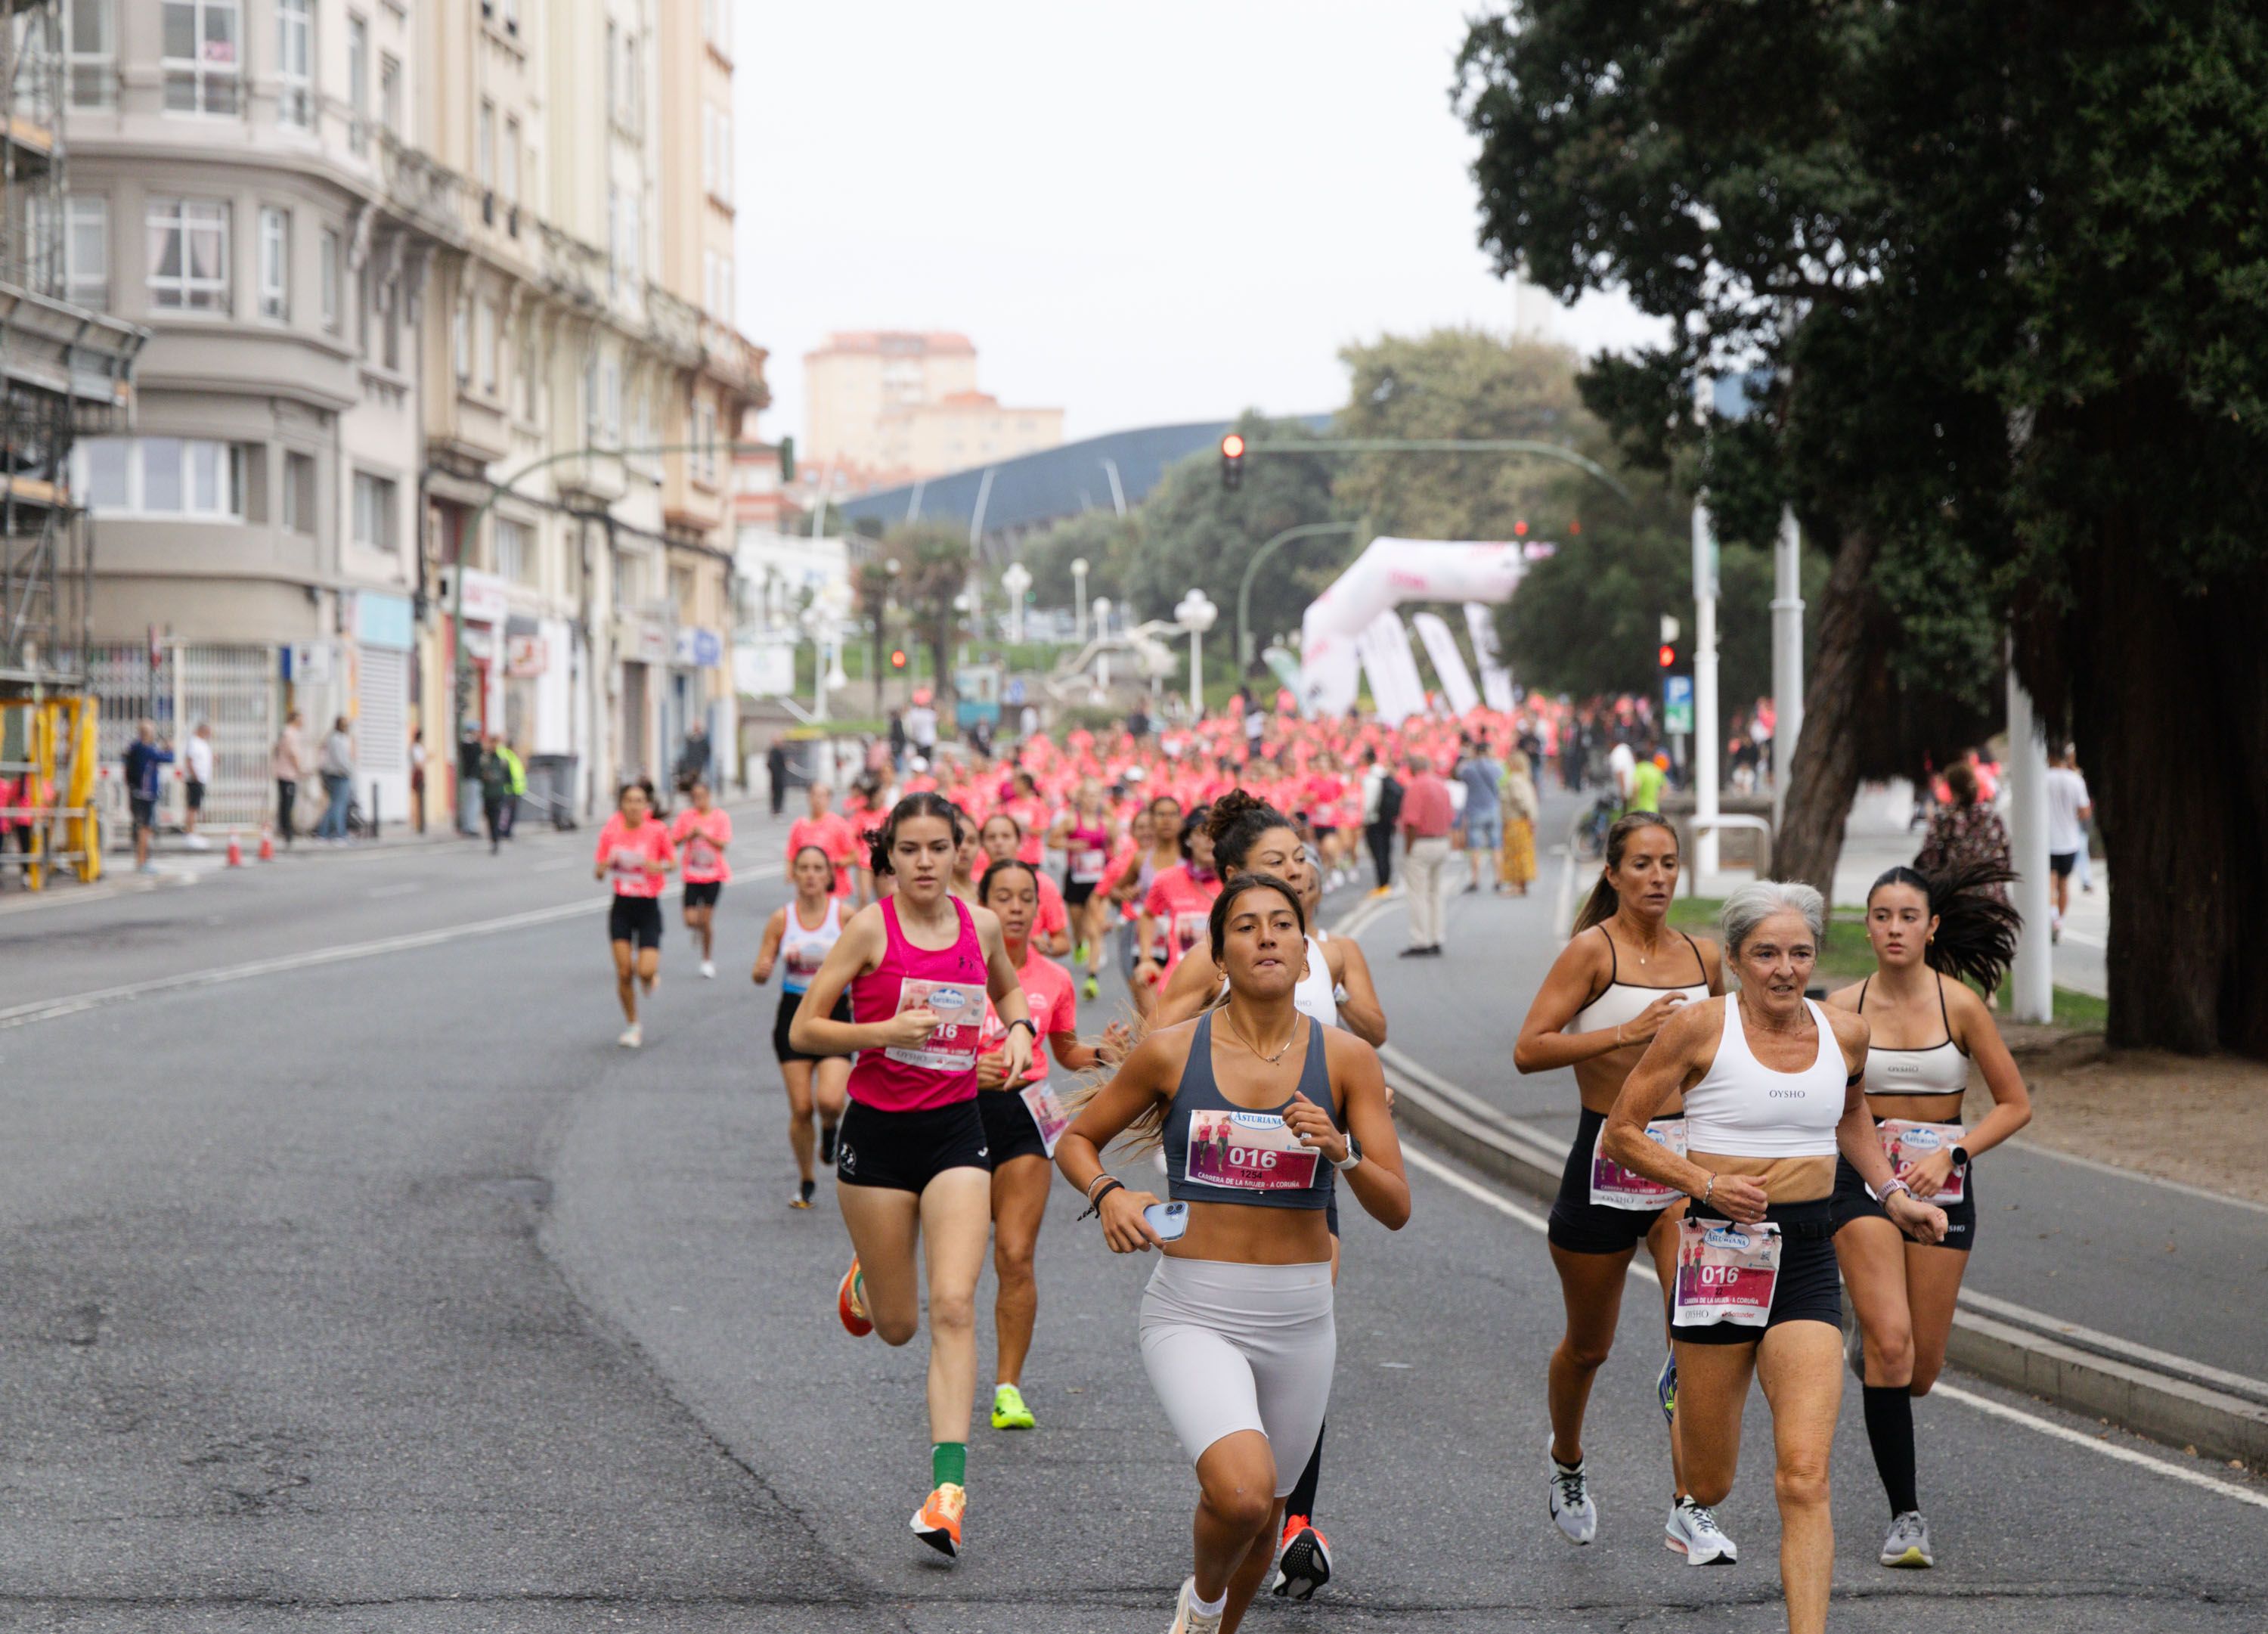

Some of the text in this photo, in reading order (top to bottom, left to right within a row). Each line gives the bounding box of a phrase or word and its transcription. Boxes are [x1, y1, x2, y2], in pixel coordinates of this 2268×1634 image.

[937, 1025, 958, 1038] 16
[1769, 1090, 1805, 1098] OYSHO
[1234, 1112, 1281, 1125] ASTURIANA
[1229, 1147, 1277, 1168] 016
[1198, 1172, 1224, 1184] CARRERA
[1225, 1177, 1234, 1186] DE
[1244, 1180, 1266, 1188] MUJER
[1241, 1170, 1263, 1179] 1254
[1707, 1232, 1746, 1247] ASTURIANA
[1702, 1267, 1739, 1284] 016
[1715, 1287, 1724, 1295] 22
